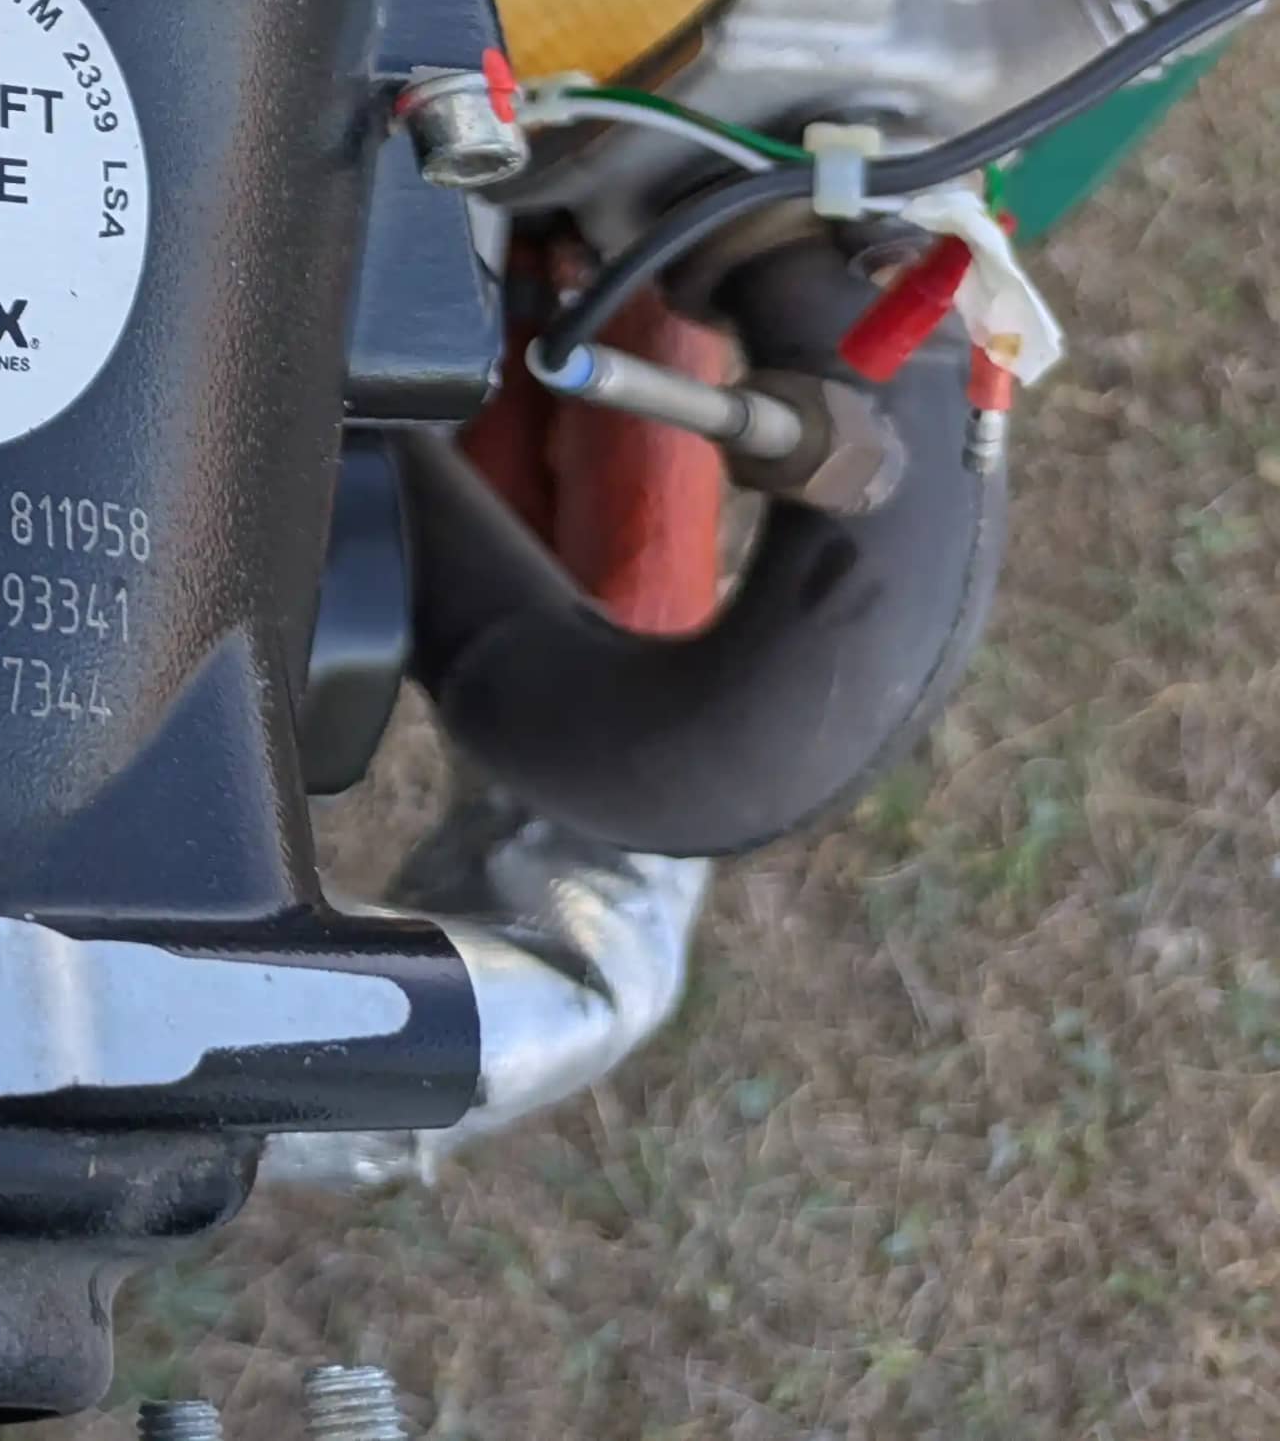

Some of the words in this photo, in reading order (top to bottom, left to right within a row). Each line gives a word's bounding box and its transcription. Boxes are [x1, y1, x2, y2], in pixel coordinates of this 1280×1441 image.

[62, 42, 119, 134] 2339
[98, 159, 129, 239] LSA
[9, 491, 151, 562] 811958
